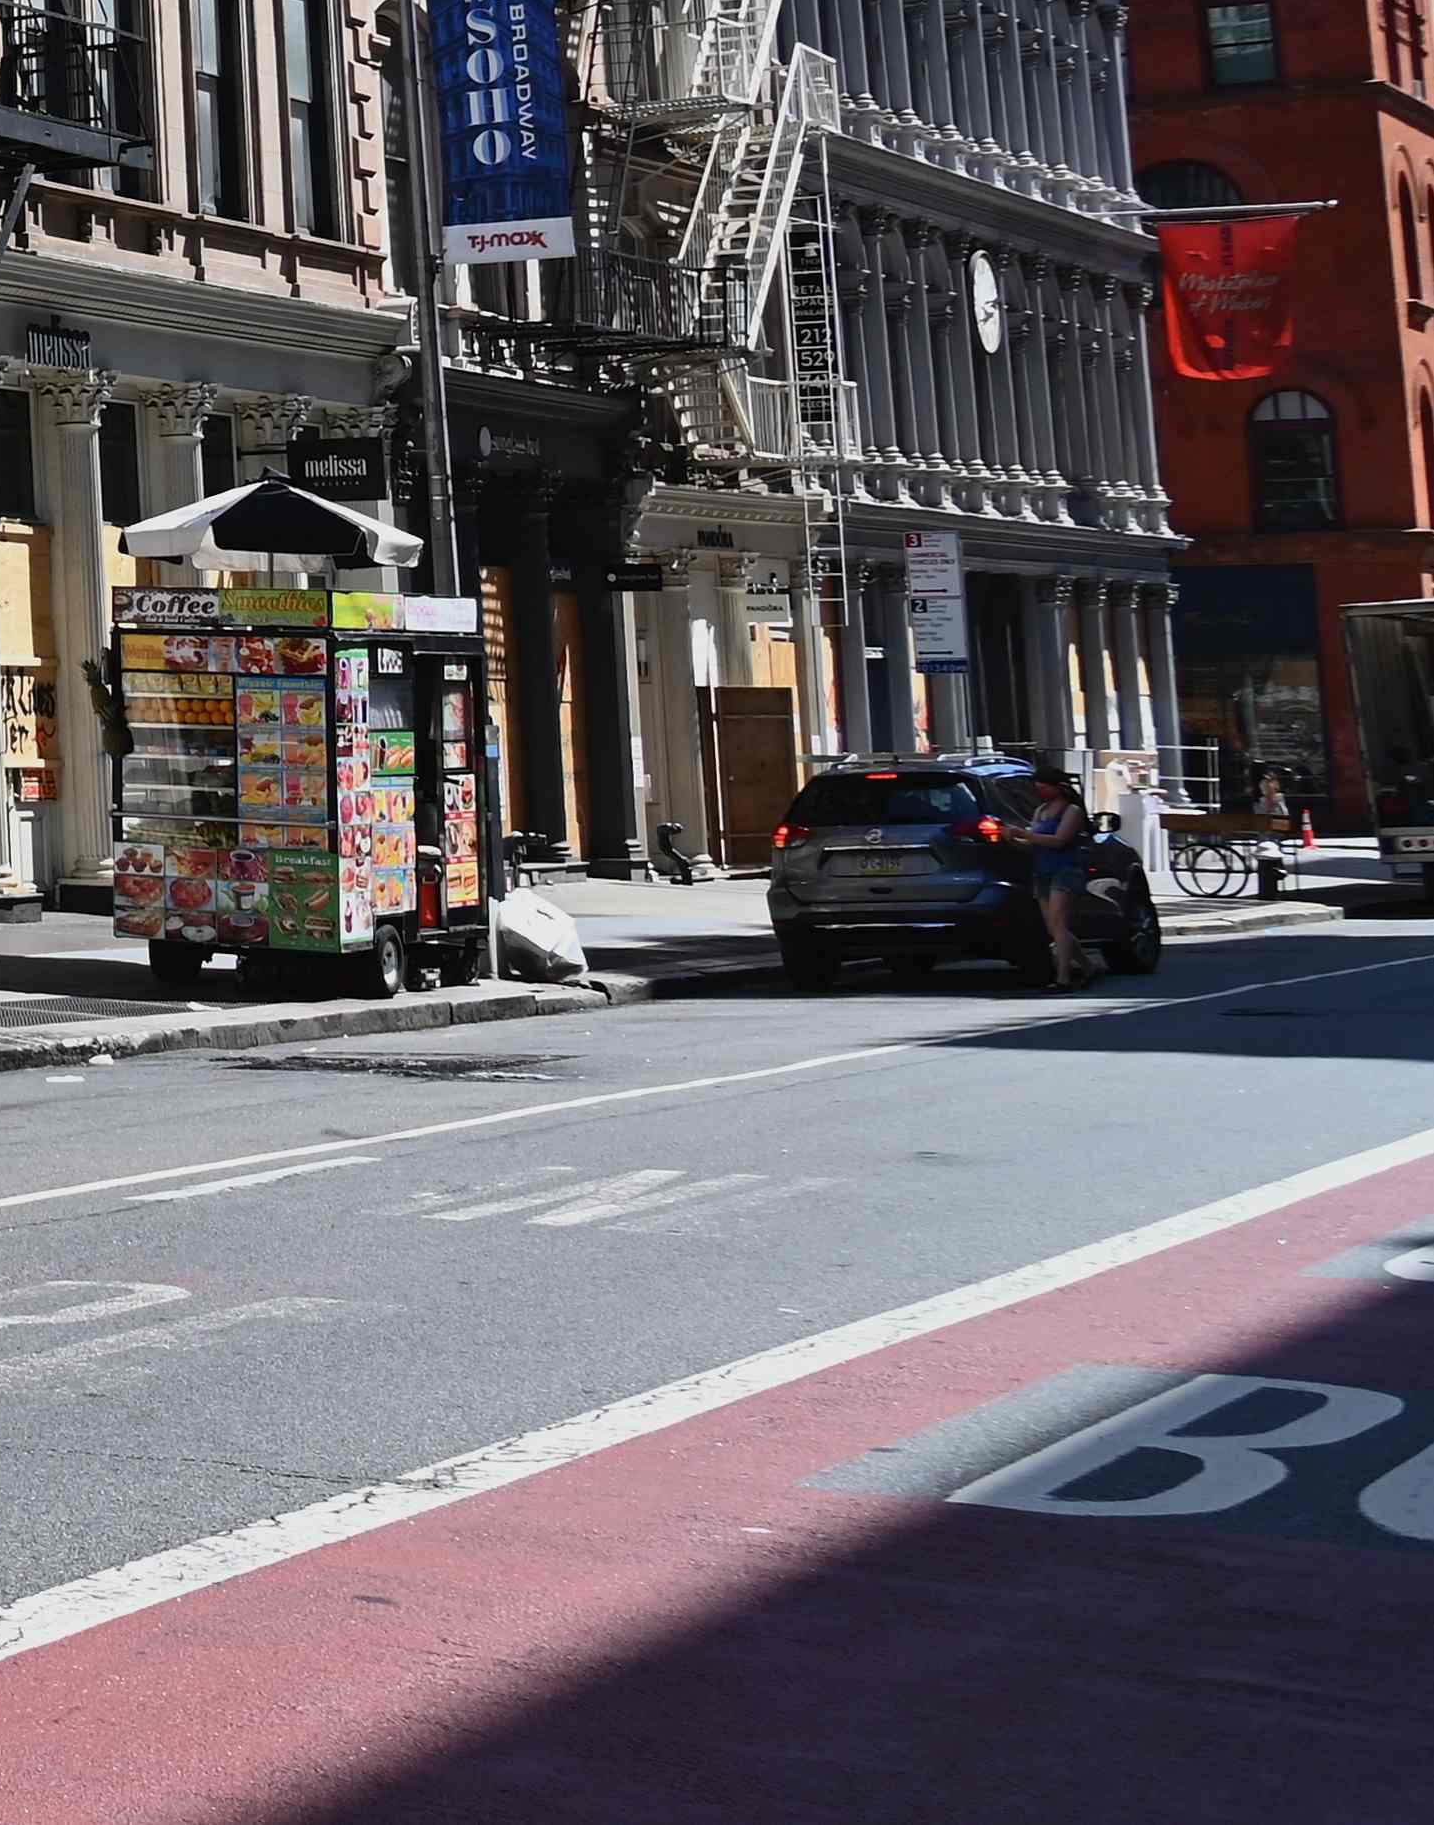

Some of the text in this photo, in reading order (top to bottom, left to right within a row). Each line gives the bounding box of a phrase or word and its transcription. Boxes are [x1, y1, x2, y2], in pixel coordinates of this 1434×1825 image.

[465, 7, 512, 165] SOHO
[509, 4, 538, 160] BROADWAY
[800, 329, 833, 343] 212
[800, 351, 835, 367] 529
[305, 455, 367, 478] melissa
[909, 534, 918, 547] 3
[136, 593, 216, 615] Coffee
[914, 600, 924, 612] 2
